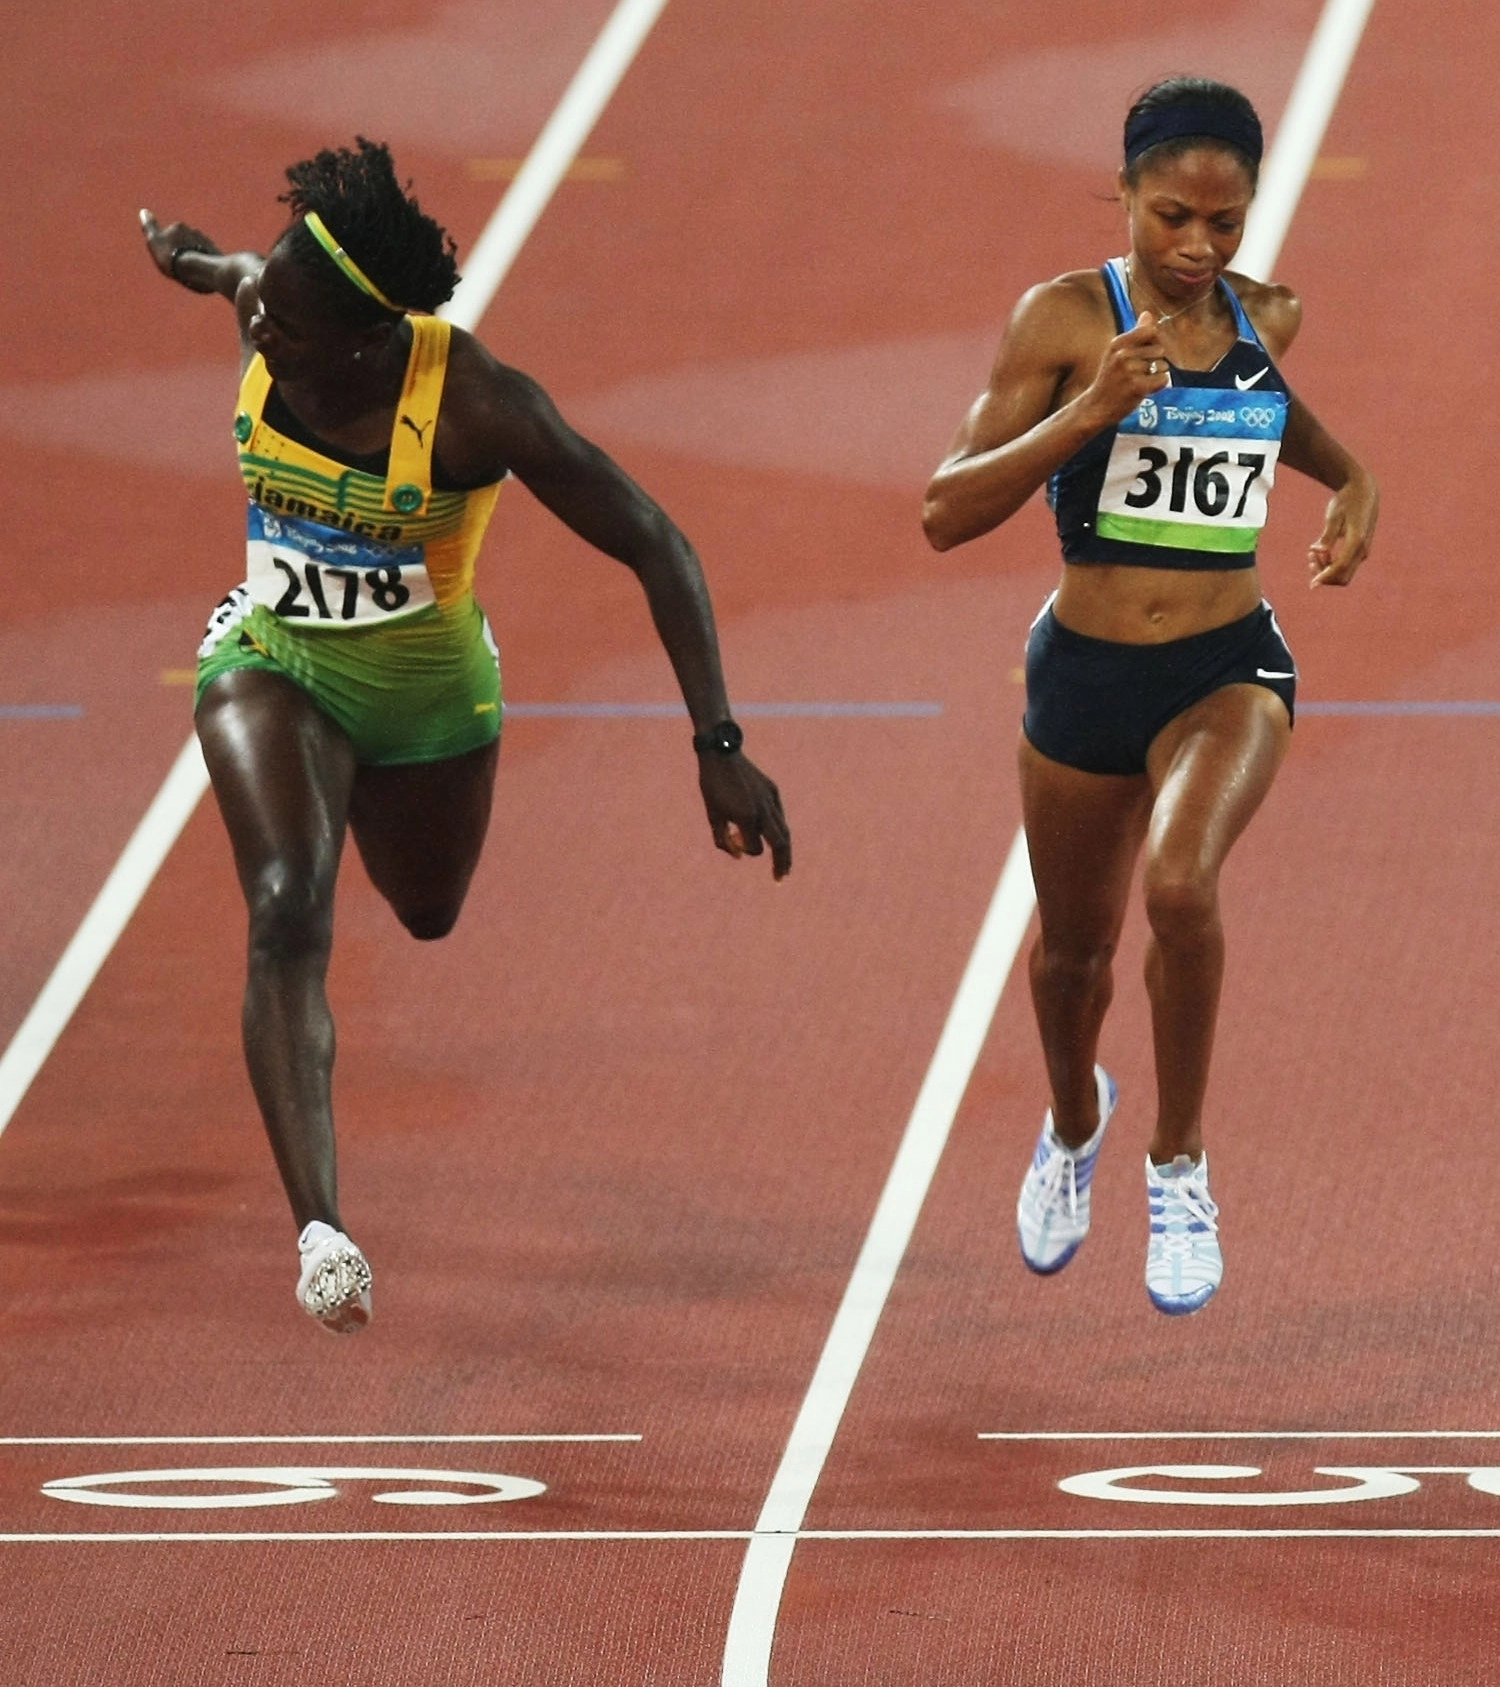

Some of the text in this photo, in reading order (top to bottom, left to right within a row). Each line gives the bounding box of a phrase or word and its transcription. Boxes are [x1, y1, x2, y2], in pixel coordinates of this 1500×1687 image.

[1163, 405, 1205, 425] Beijing
[254, 475, 402, 541] jamaica
[1124, 446, 1266, 518] 3167
[273, 556, 411, 621] 2178
[40, 1465, 549, 1509] 6
